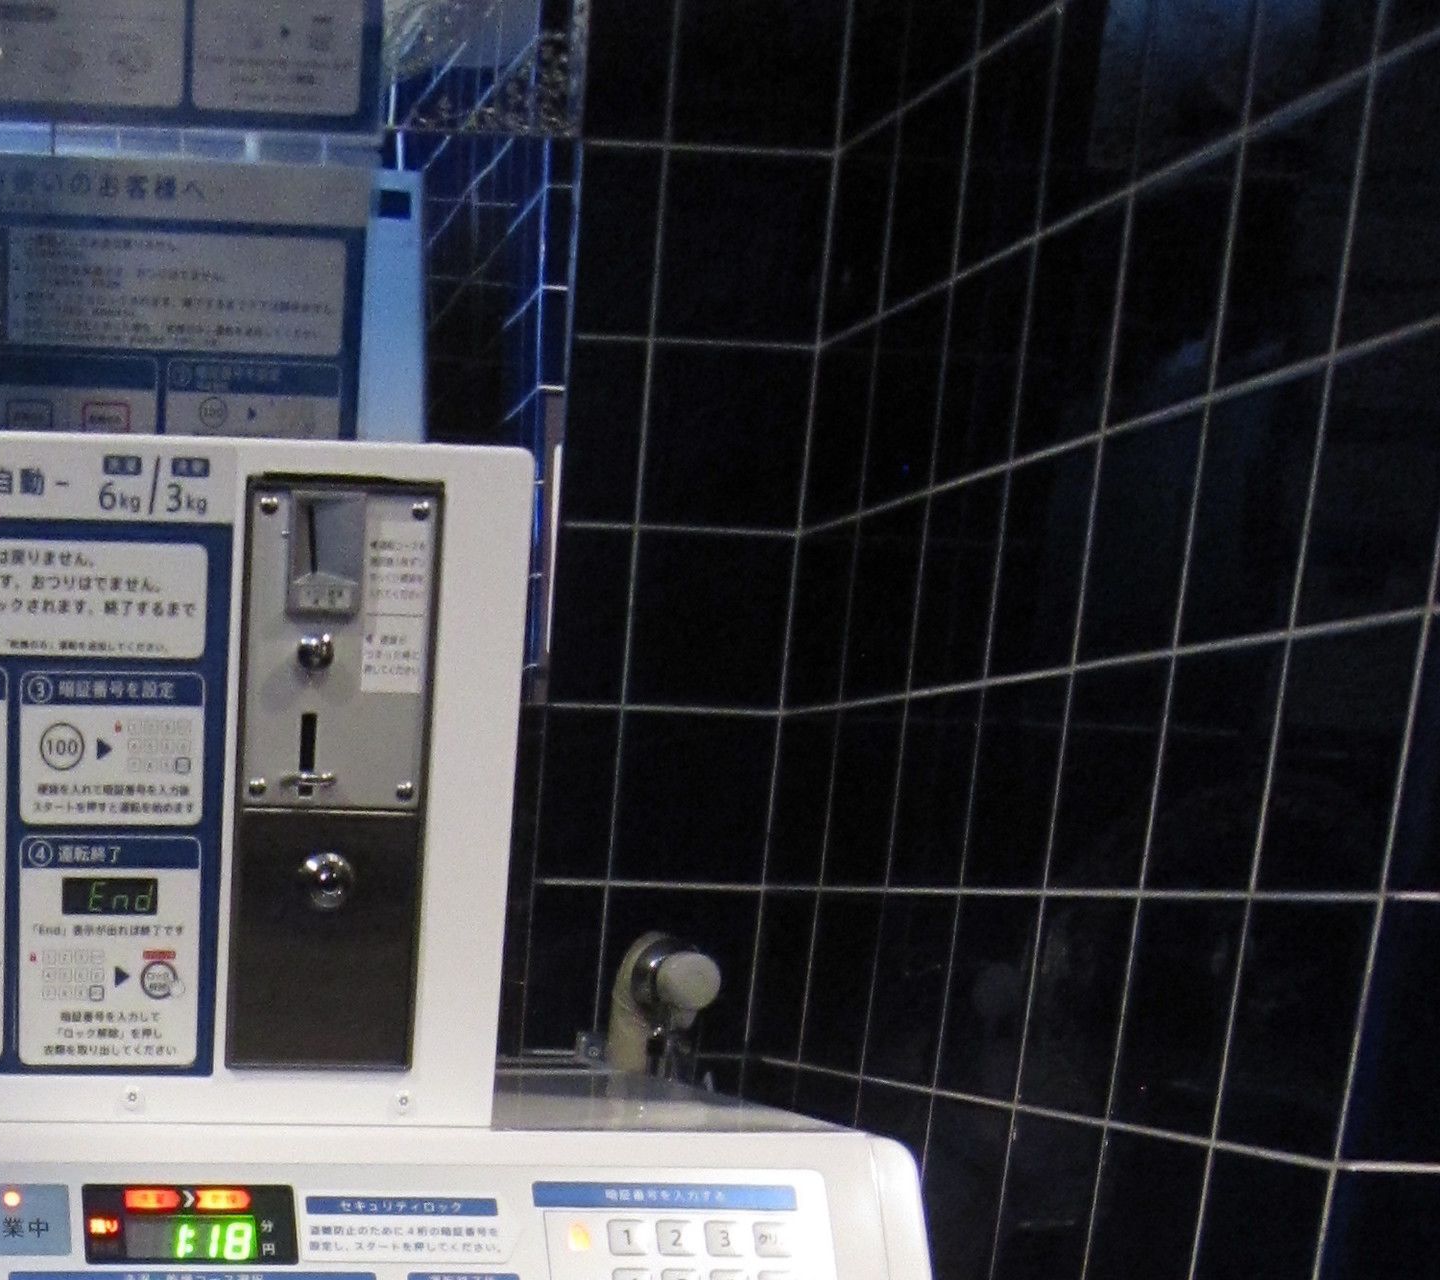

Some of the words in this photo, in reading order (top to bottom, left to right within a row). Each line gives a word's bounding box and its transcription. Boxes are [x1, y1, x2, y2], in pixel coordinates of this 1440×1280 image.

[98, 482, 141, 513] 6kg
[166, 484, 208, 515] 3kg
[46, 739, 78, 756] 100
[88, 881, 153, 912] End
[339, 1201, 462, 1213] セキュリティロック
[623, 1229, 633, 1246] 1
[671, 1230, 683, 1247] 2
[720, 1231, 731, 1248] 3
[262, 1243, 276, 1256] 円
